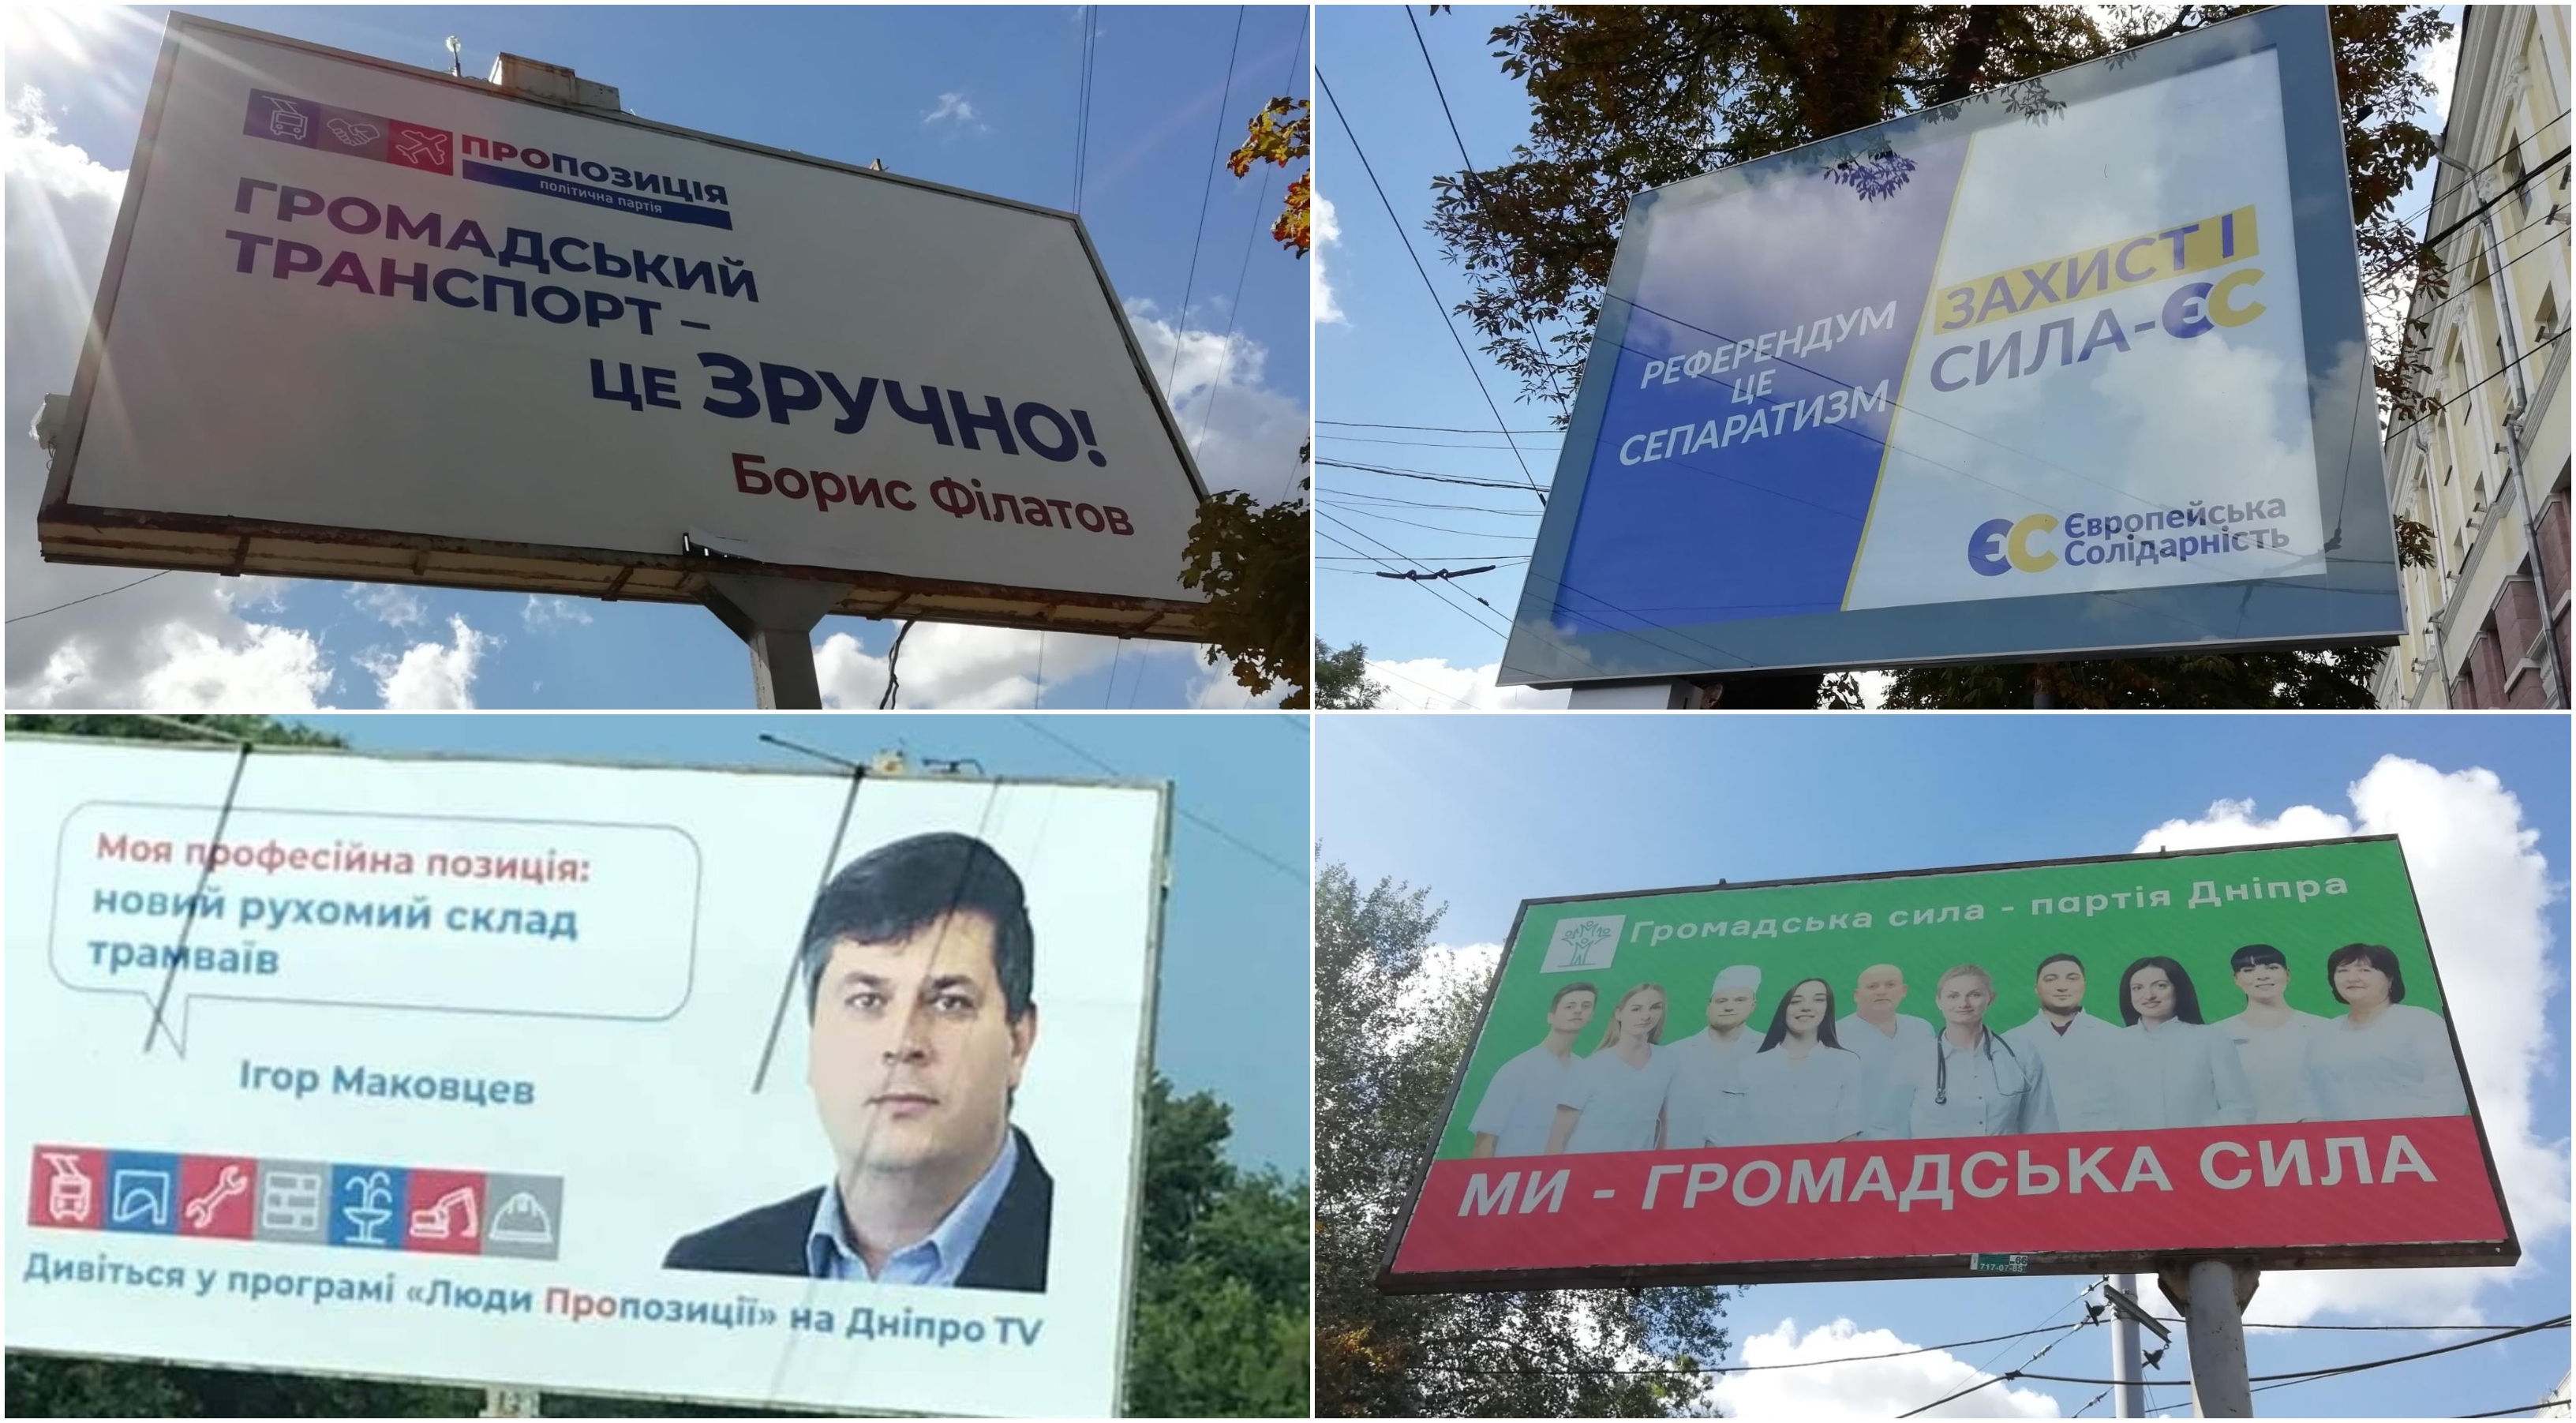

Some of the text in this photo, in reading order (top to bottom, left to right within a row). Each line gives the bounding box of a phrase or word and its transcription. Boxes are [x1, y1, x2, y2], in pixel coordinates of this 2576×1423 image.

[461, 134, 729, 206] ПРОПОЗИЦІЯ
[540, 179, 663, 215] політична партія
[234, 177, 759, 303] ГРОМАДСЬКИЙ
[224, 229, 662, 335] ТРАНСПОРТ
[1941, 223, 2200, 331] ЗАХИСТ
[1640, 300, 1897, 390] РЕФЕРЕНДУМ
[590, 352, 1107, 468] ЦЕ ЗРУЧНО!
[1619, 379, 1889, 466] СЕПАРАТИЗМ
[1731, 369, 1777, 405] ЦЕ
[731, 452, 1135, 537] Борис Філатов
[2065, 497, 2287, 539] Європейська
[1968, 513, 2060, 577] ЄС
[2065, 525, 2290, 567] Солідарність
[96, 831, 590, 884] Моя професійна позиція:
[92, 885, 579, 941] новий рухомий склад
[1630, 912, 1873, 947] Громадська
[1889, 904, 1985, 928] сила
[2031, 885, 2171, 917] партія
[2188, 876, 2349, 910] Дніпра
[88, 937, 279, 976] трамваїв
[240, 1059, 536, 1107] Ігор Маковцев
[1457, 1169, 1571, 1217] МИ
[1641, 1145, 2174, 1212] ГРОМАДСЬКА
[2199, 1135, 2439, 1191] СИЛА
[22, 1251, 185, 1289] Дивіться
[195, 1268, 216, 1296] у
[228, 1271, 395, 1305] програмі
[406, 1280, 532, 1314] «Люди
[545, 1286, 777, 1327] Пропозиції»
[789, 1309, 835, 1333] на
[844, 1305, 985, 1345] Дніпро
[1979, 1263, 2023, 1272] 717-07-85
